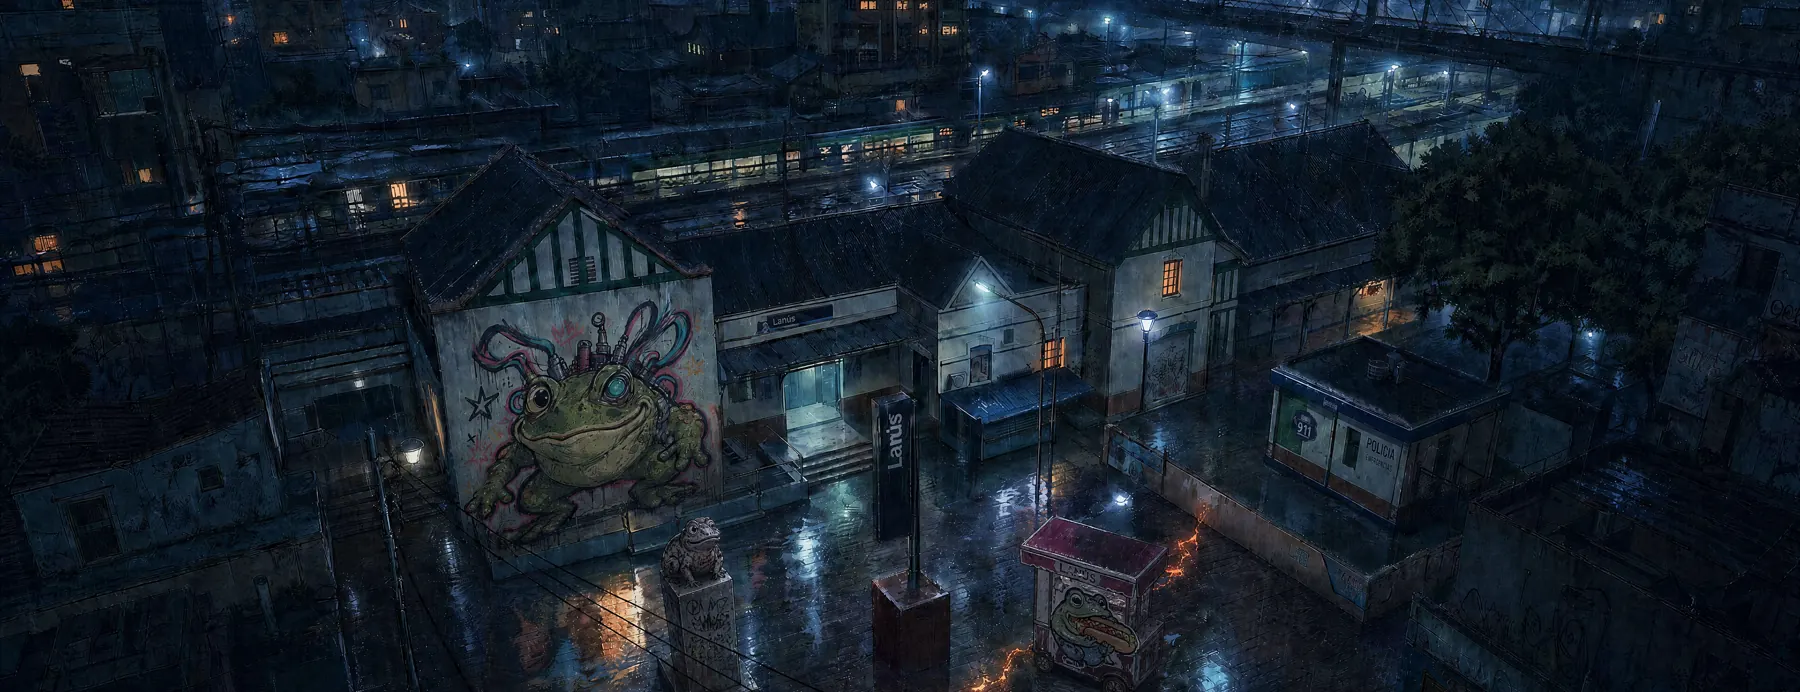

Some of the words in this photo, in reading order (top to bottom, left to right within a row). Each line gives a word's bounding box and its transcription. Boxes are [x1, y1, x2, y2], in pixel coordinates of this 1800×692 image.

[772, 315, 796, 326] Lanús
[1297, 421, 1311, 437] 911
[886, 413, 903, 470] Lanús
[1366, 437, 1395, 461] POLICIA
